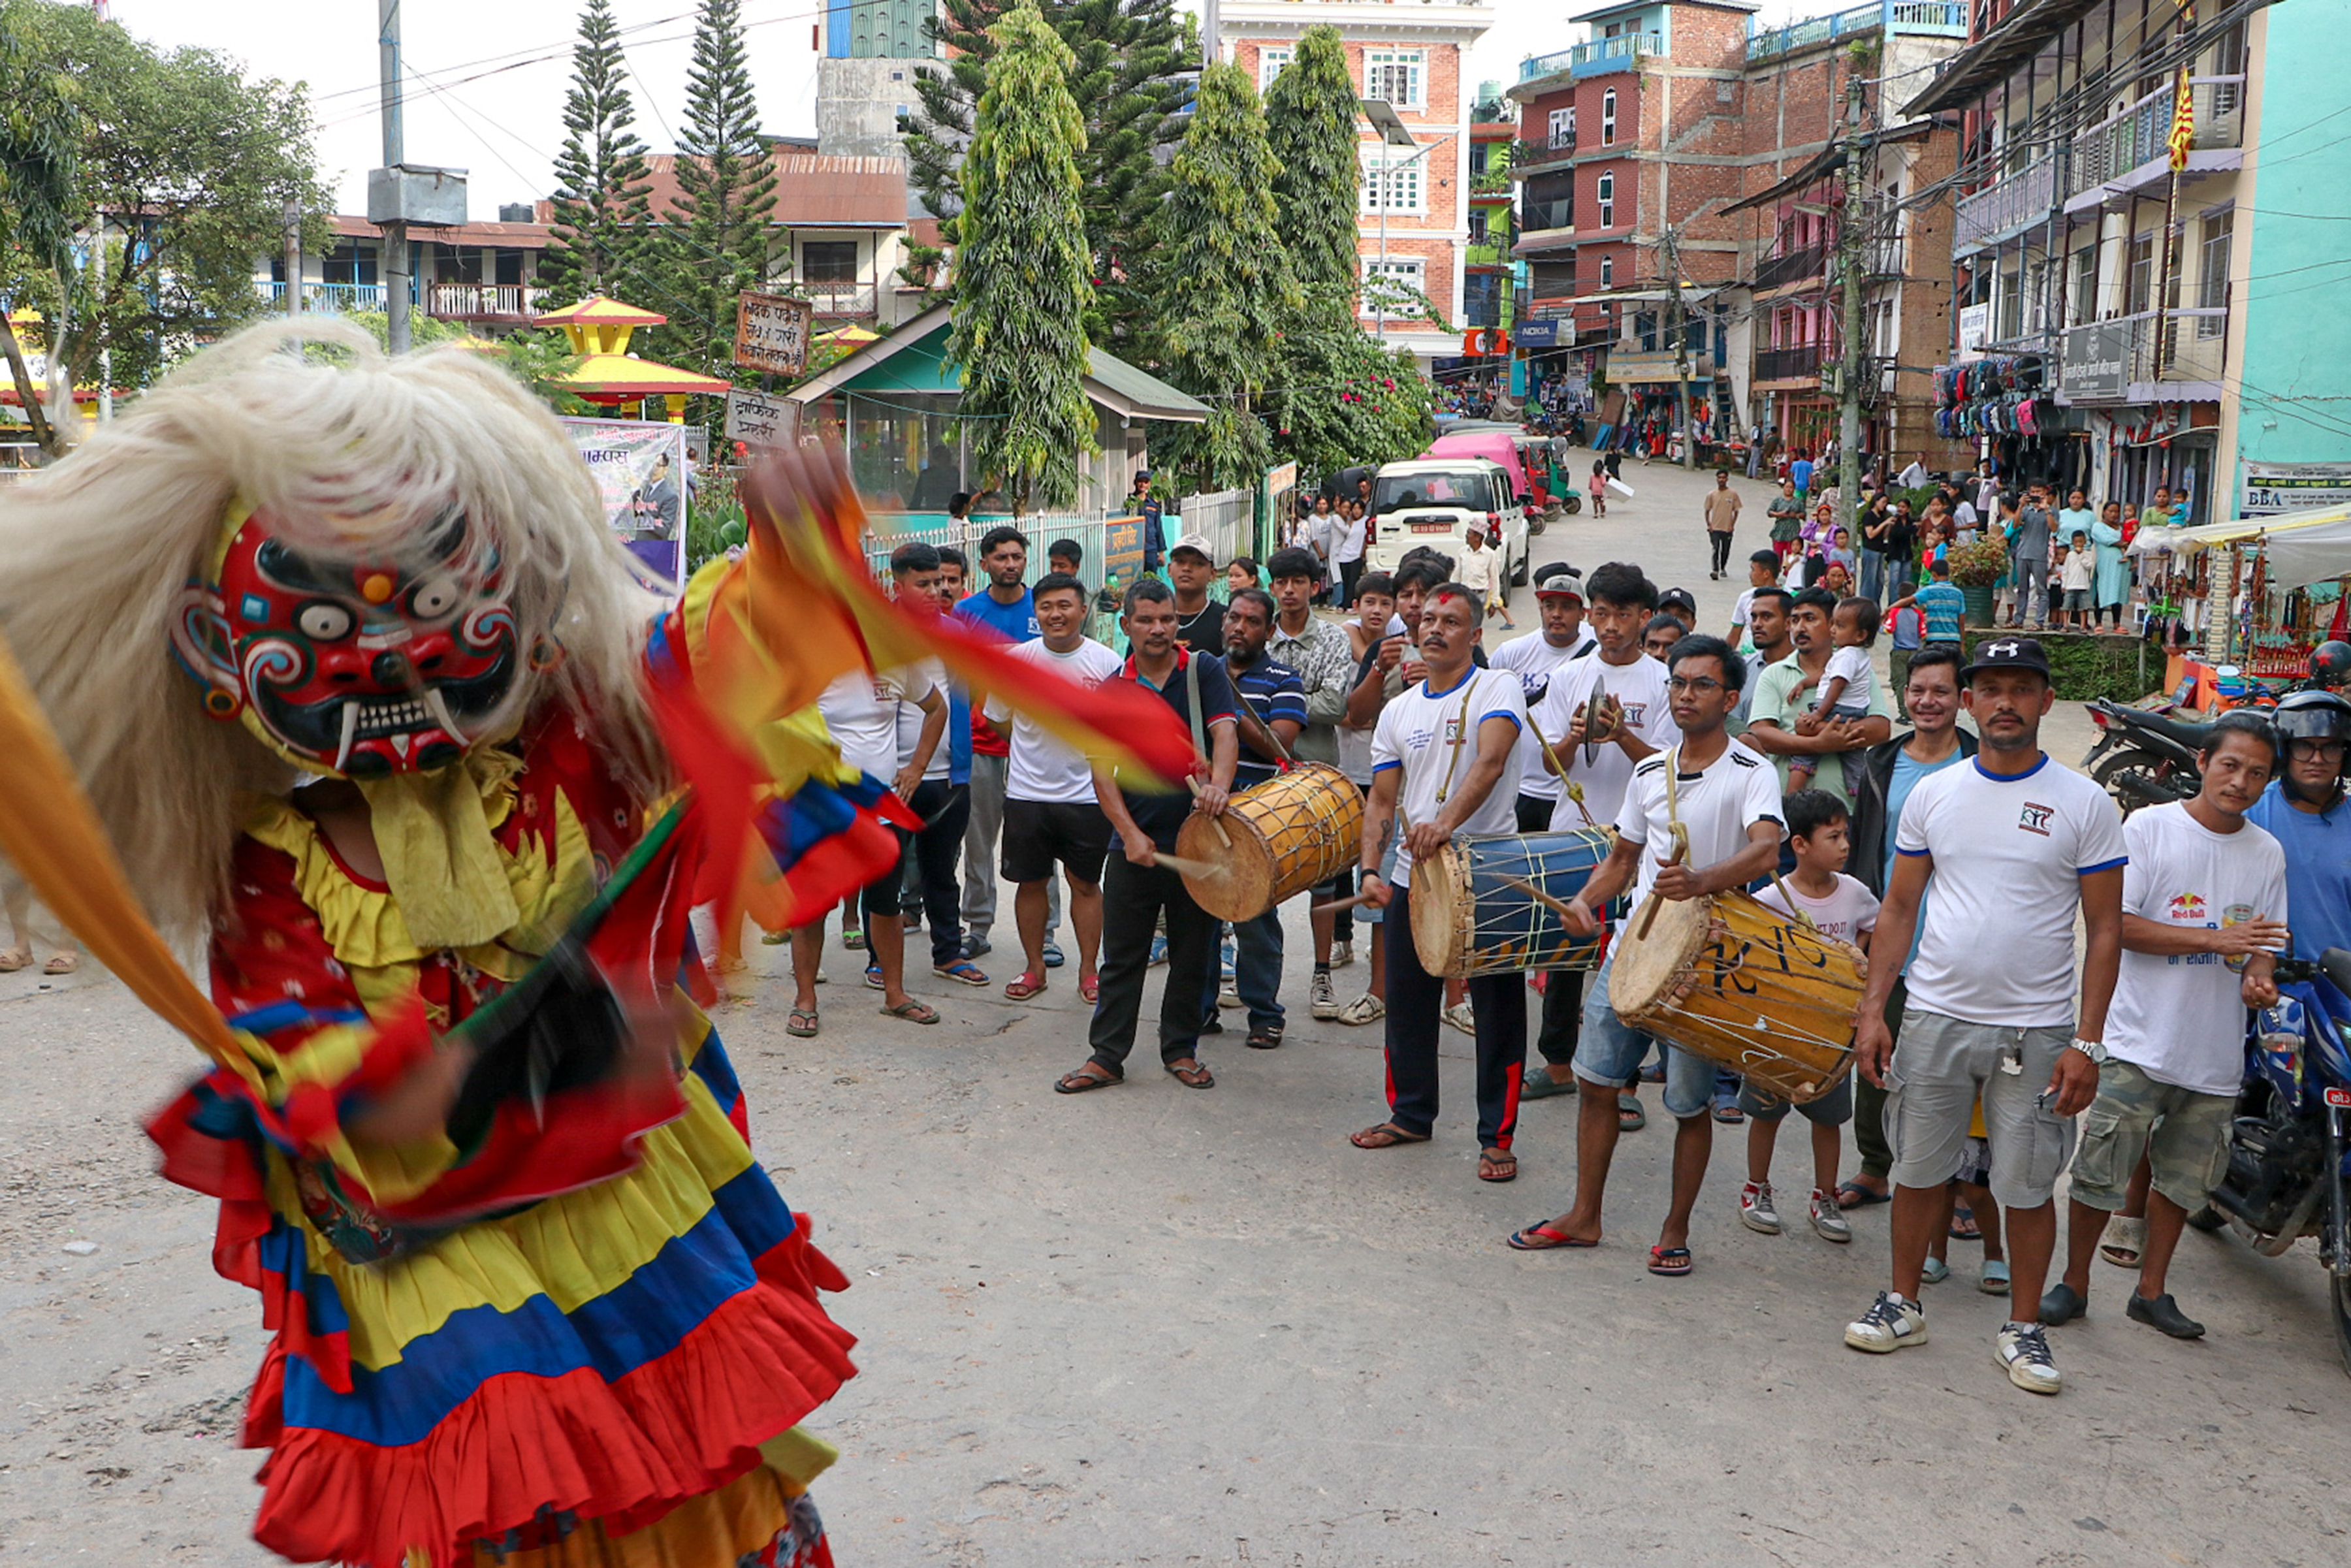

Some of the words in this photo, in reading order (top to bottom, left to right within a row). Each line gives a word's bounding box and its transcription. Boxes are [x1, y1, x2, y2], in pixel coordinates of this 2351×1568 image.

[1522, 327, 1550, 336] NOKIA
[2248, 491, 2282, 506] BBA
[2172, 910, 2188, 919] Red
[2189, 908, 2205, 918] Bull
